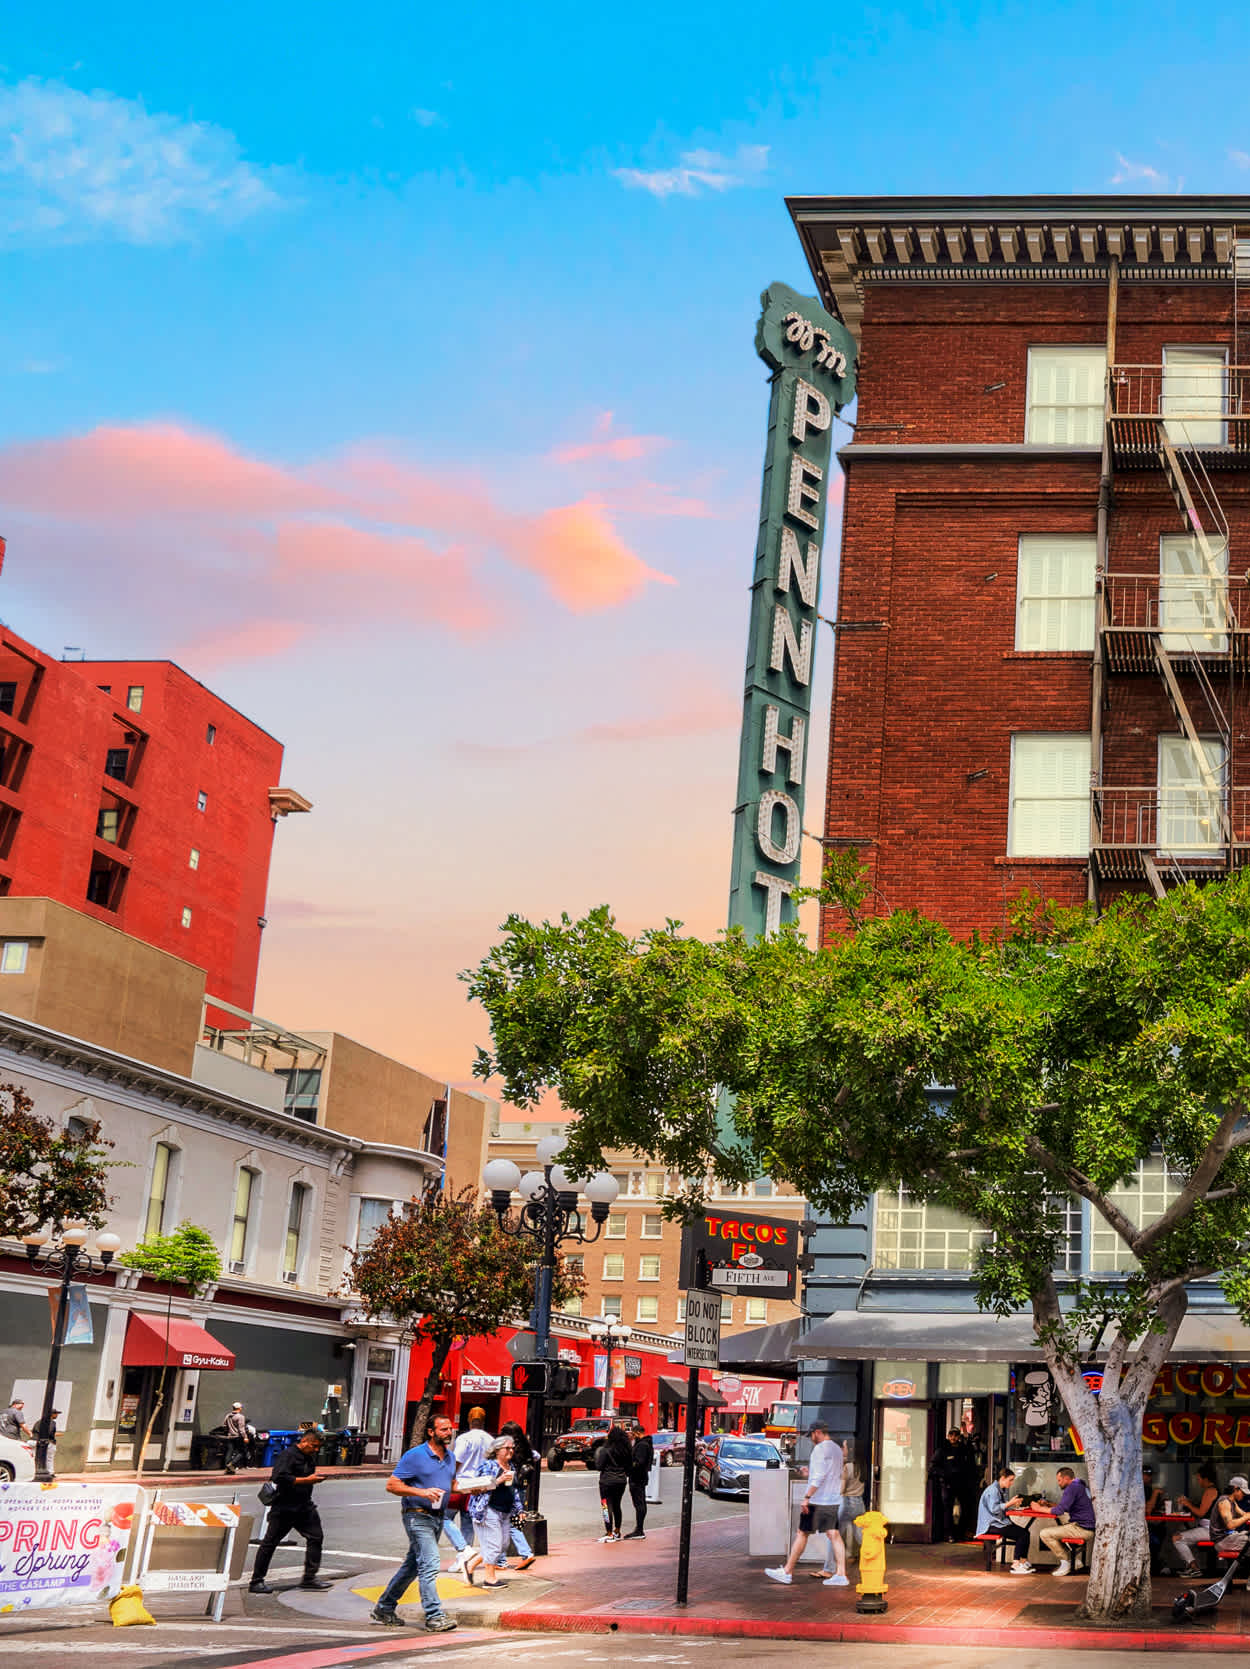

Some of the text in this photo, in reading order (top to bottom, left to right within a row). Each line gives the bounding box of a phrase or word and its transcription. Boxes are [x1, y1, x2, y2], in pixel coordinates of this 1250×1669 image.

[769, 376, 832, 687] PENN
[704, 1216, 788, 1246] TACOS
[726, 1271, 760, 1284] FIFTH
[688, 1300, 719, 1320] DO NOT
[687, 1325, 717, 1345] BLOCK
[192, 1355, 229, 1366] Gyu-Kaku
[686, 1347, 717, 1361] INTERSECTION
[881, 1383, 917, 1396] OPEN
[13, 1543, 90, 1582] Sprung
[19, 1578, 65, 1590] GASLAMP
